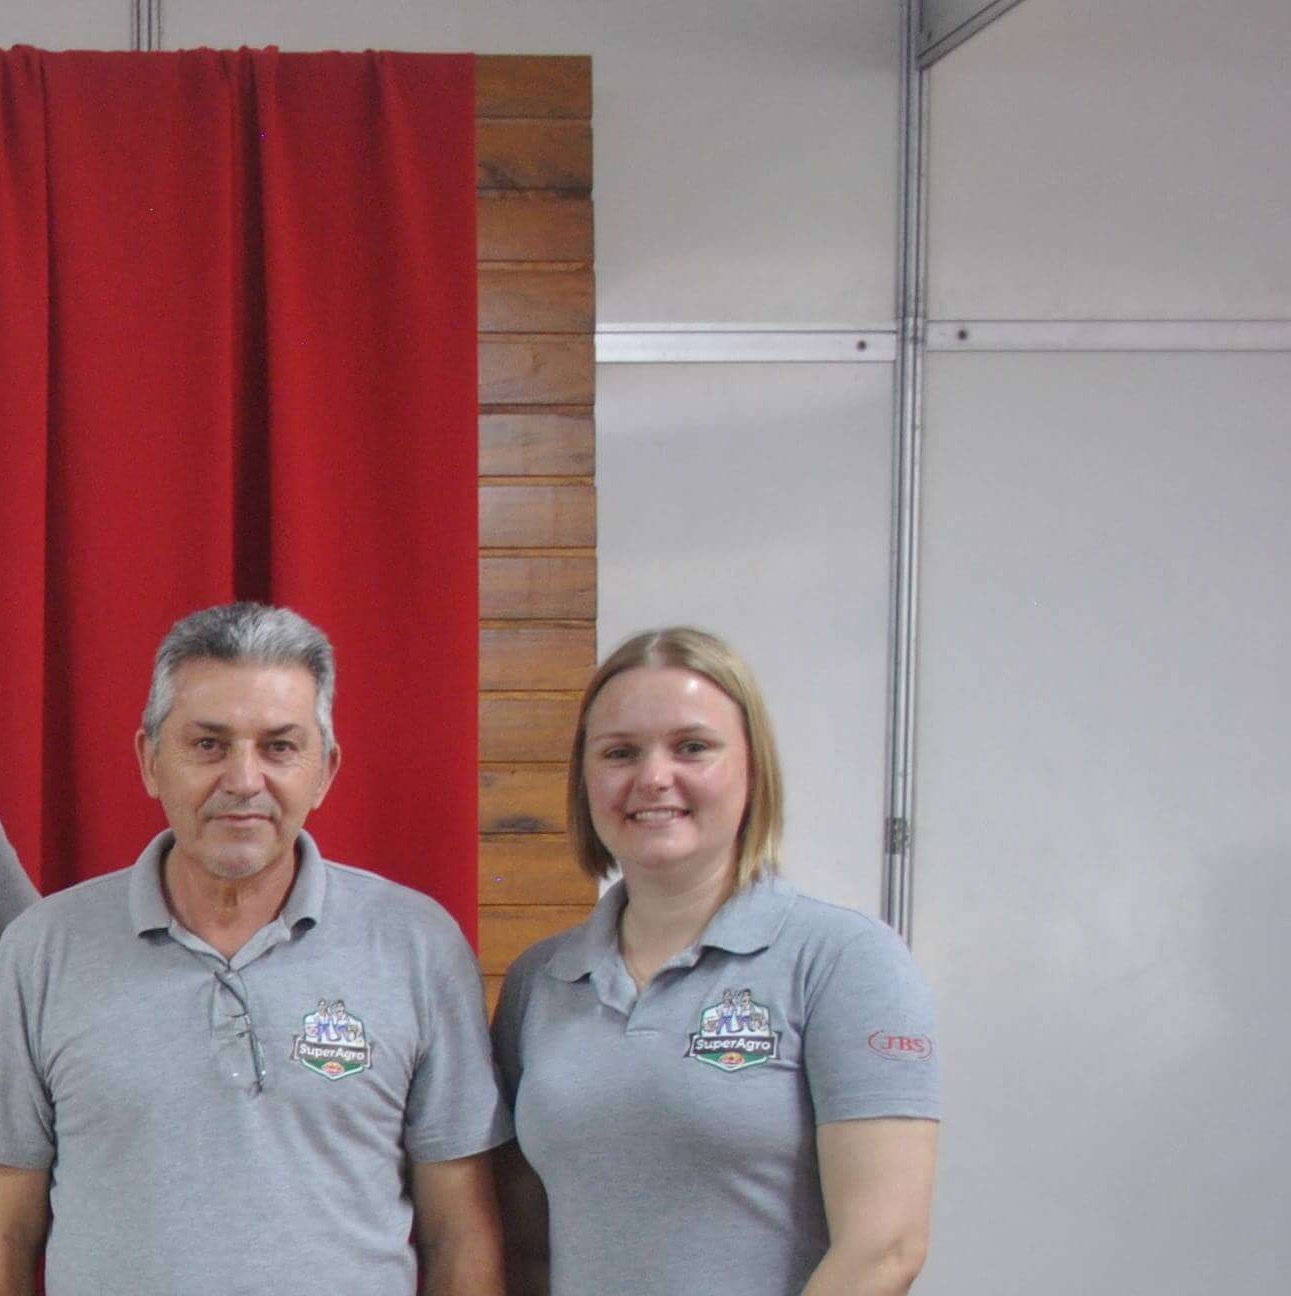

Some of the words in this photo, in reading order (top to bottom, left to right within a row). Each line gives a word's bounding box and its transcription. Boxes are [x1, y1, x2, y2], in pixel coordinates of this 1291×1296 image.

[299, 1043, 365, 1061] SuperAgro
[695, 1038, 771, 1052] SuperAgro
[880, 1036, 924, 1053] JBS
